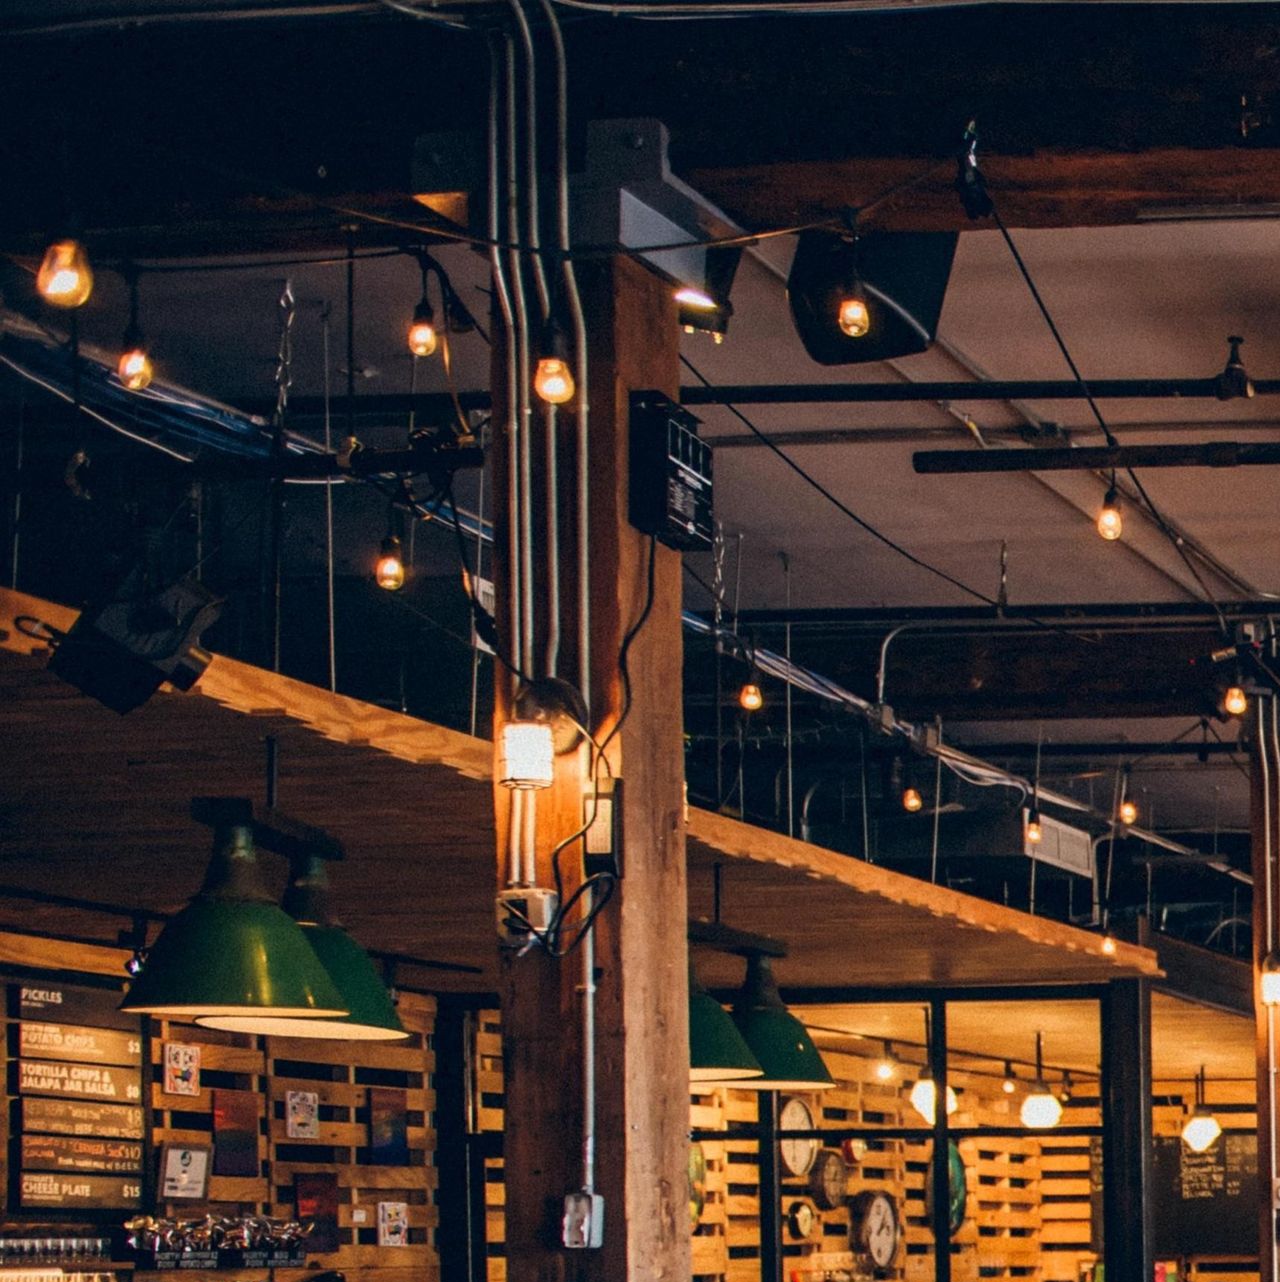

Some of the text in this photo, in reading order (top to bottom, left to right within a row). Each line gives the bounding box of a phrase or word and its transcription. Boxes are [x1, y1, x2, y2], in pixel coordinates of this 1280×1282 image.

[21, 988, 62, 1004] PICKLES
[21, 1031, 63, 1044] POTATO
[64, 1034, 96, 1047] CHIPS
[21, 1063, 68, 1079] TORTILLA
[70, 1067, 101, 1083] CHIPS
[21, 1076, 60, 1091] JALAPA
[63, 1080, 82, 1093] JAR
[84, 1082, 116, 1096] SALSA
[22, 1182, 140, 1198] CHEESE PLATE $15
